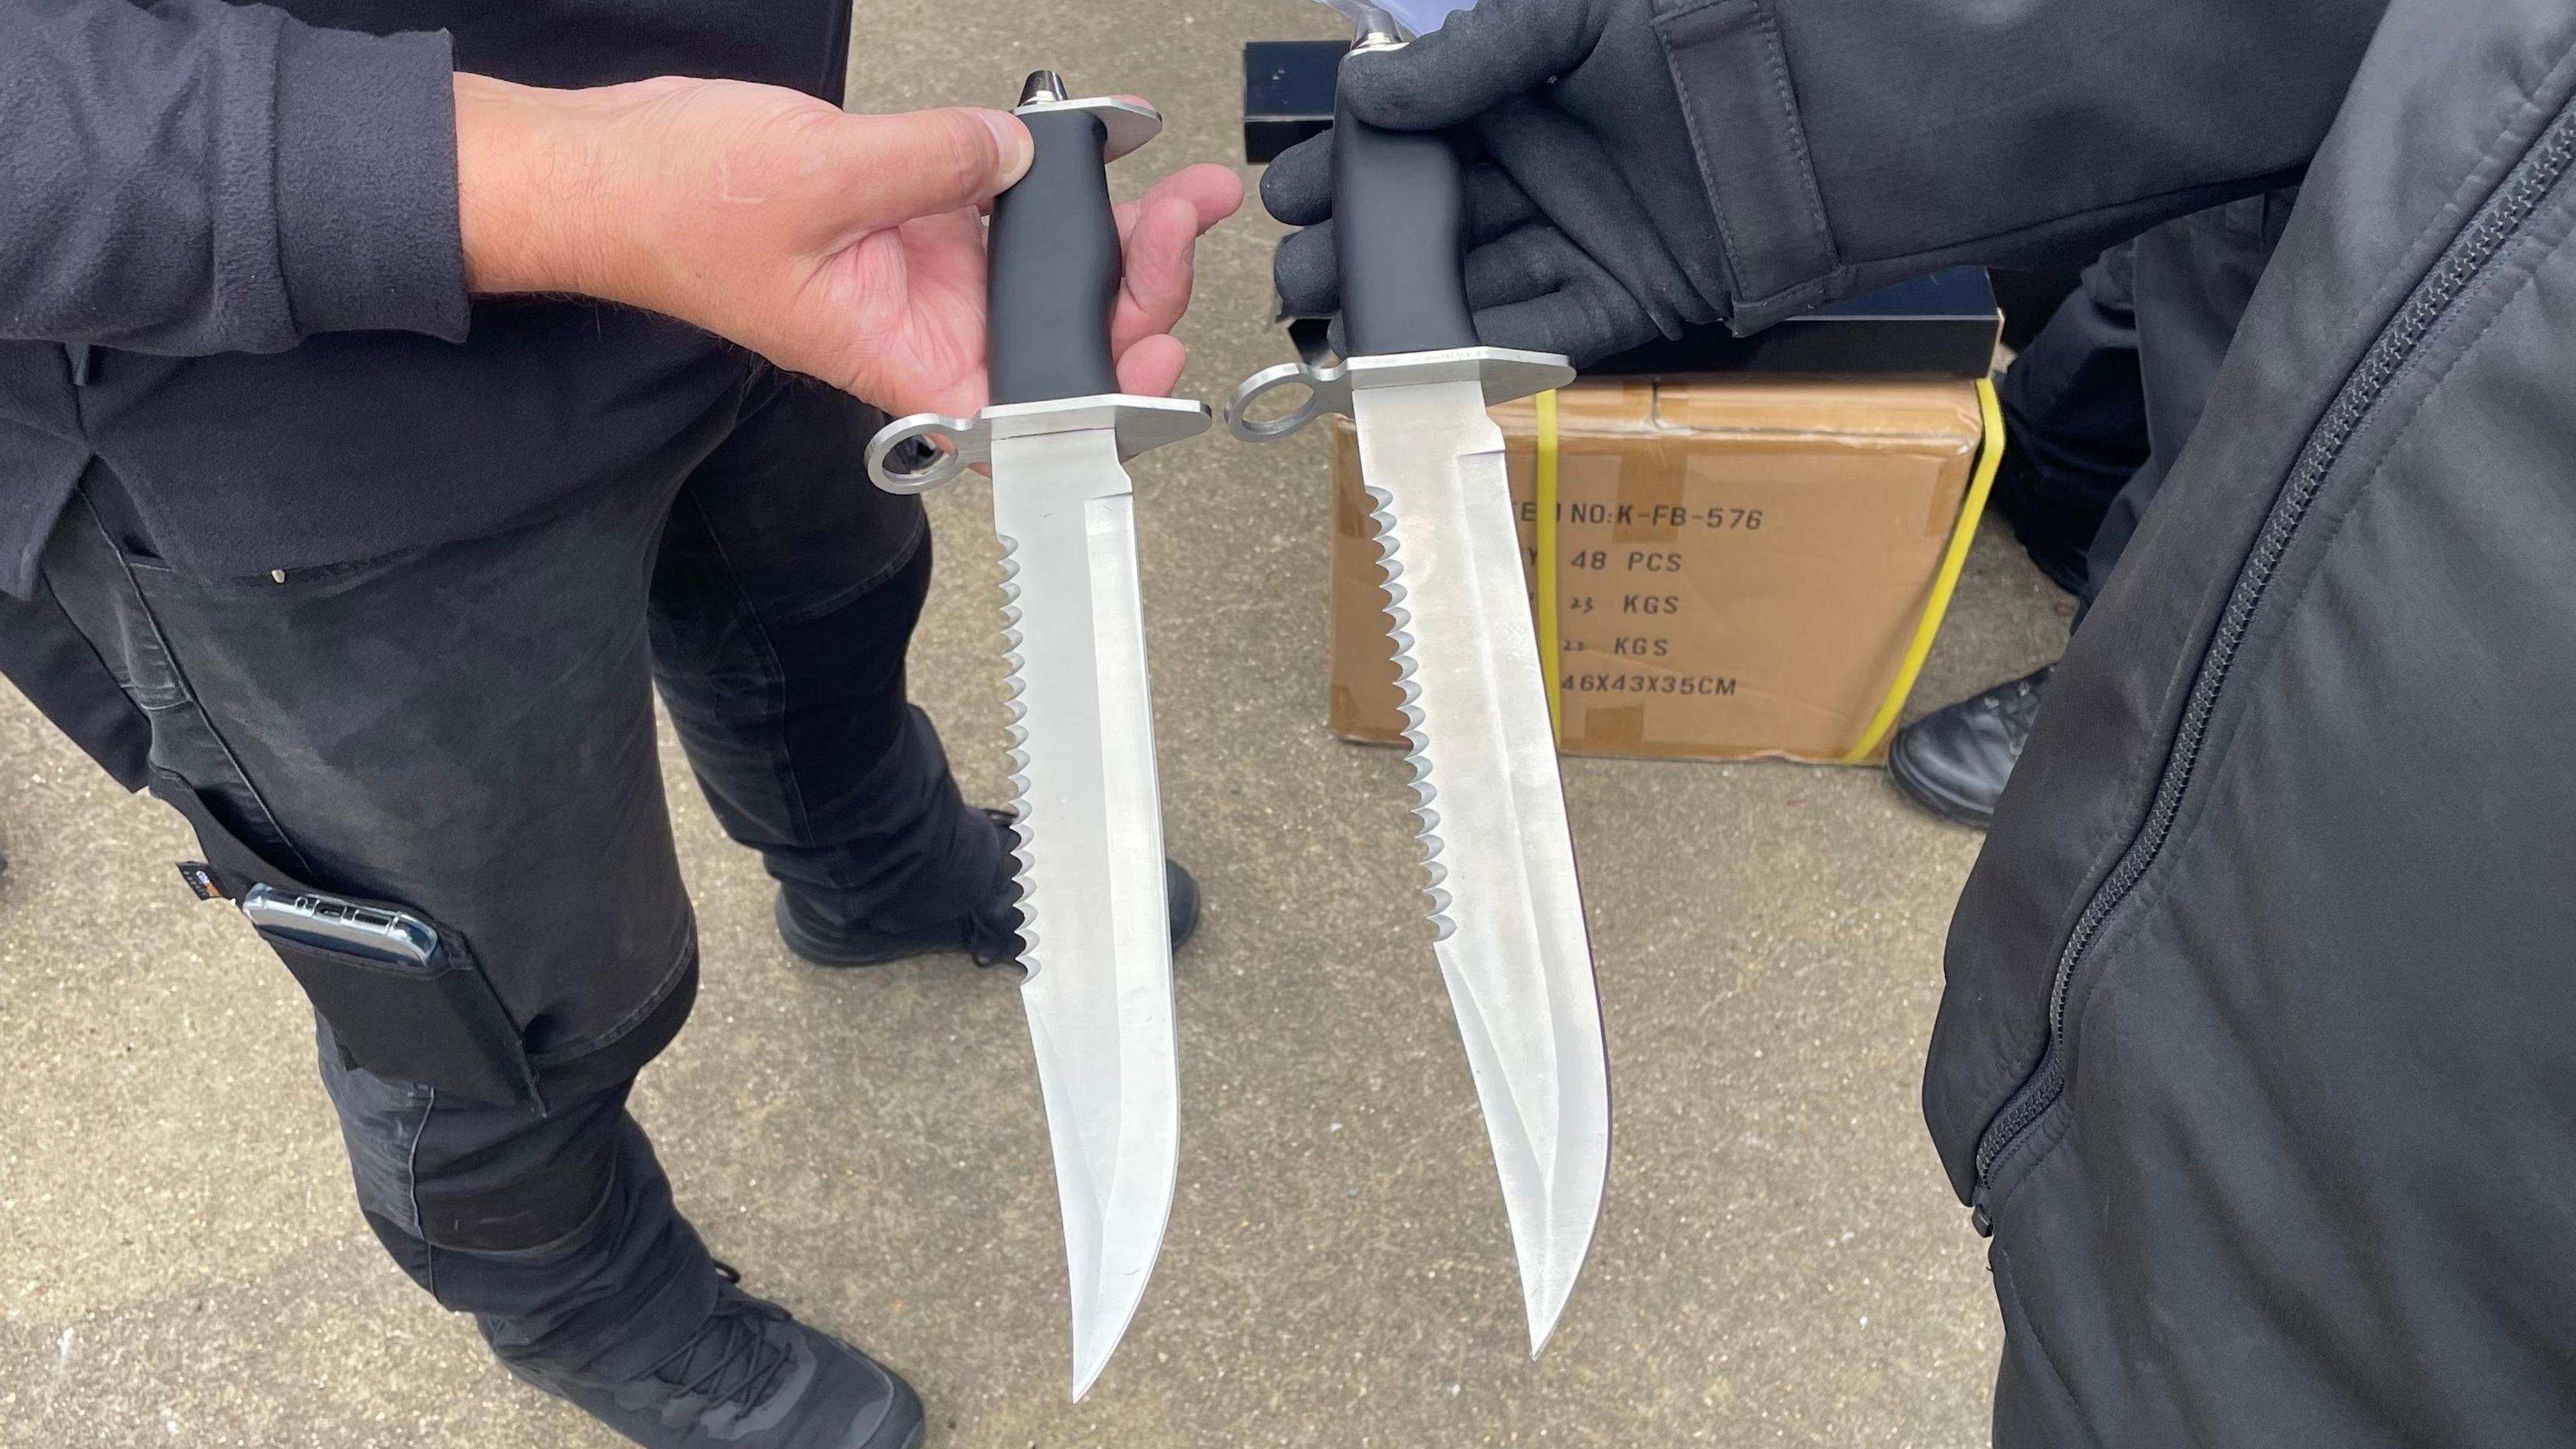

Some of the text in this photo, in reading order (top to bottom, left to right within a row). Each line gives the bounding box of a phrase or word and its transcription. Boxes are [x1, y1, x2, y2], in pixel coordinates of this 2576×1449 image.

[1570, 551, 1682, 572] 48 PCS
[1623, 594, 1678, 614] KGS
[1614, 637, 1668, 657] KGS
[1562, 674, 1736, 696] 46X43X35CM
